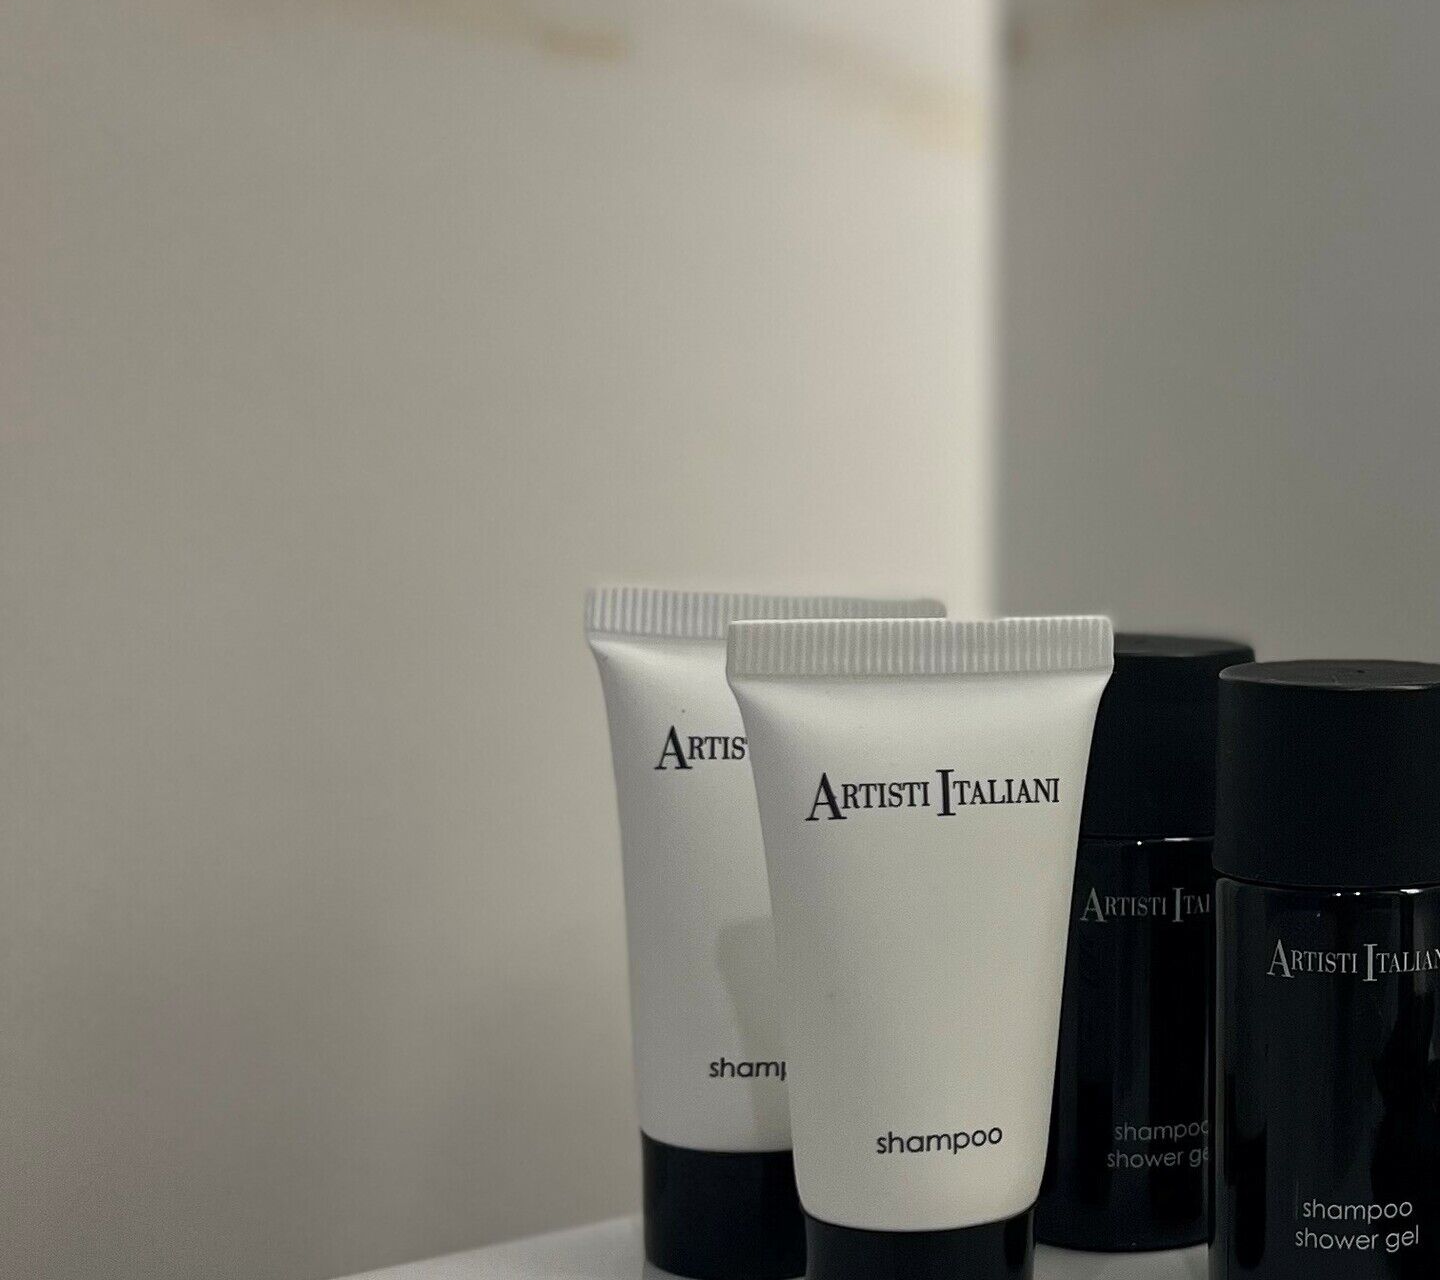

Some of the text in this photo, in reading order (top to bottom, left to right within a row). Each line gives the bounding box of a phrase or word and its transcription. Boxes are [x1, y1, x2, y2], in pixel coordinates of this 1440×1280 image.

[653, 725, 748, 770] ARTIS
[805, 769, 1060, 821] ARTISTI ITALIANI
[1079, 886, 1167, 923] ARTISTI
[1267, 938, 1358, 979] ARTISTI
[709, 1057, 787, 1081] sham
[876, 1127, 1003, 1155] shampoo
[1107, 1149, 1184, 1168] shower
[1303, 1198, 1413, 1225] shampoo
[1295, 1224, 1419, 1253] shower gel
